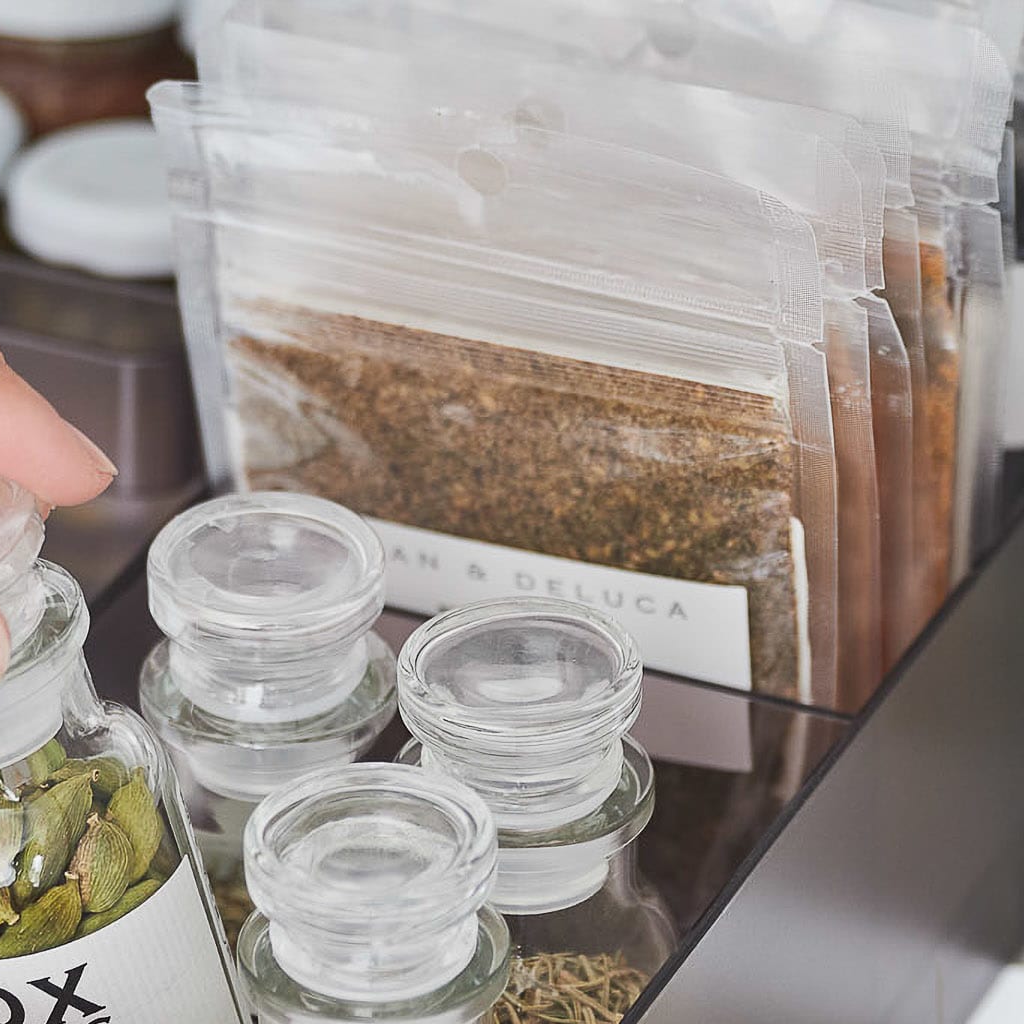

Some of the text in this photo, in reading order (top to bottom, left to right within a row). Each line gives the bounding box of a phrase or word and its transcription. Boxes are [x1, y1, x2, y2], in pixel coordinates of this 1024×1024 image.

[391, 545, 689, 620] AN & DELUCA
